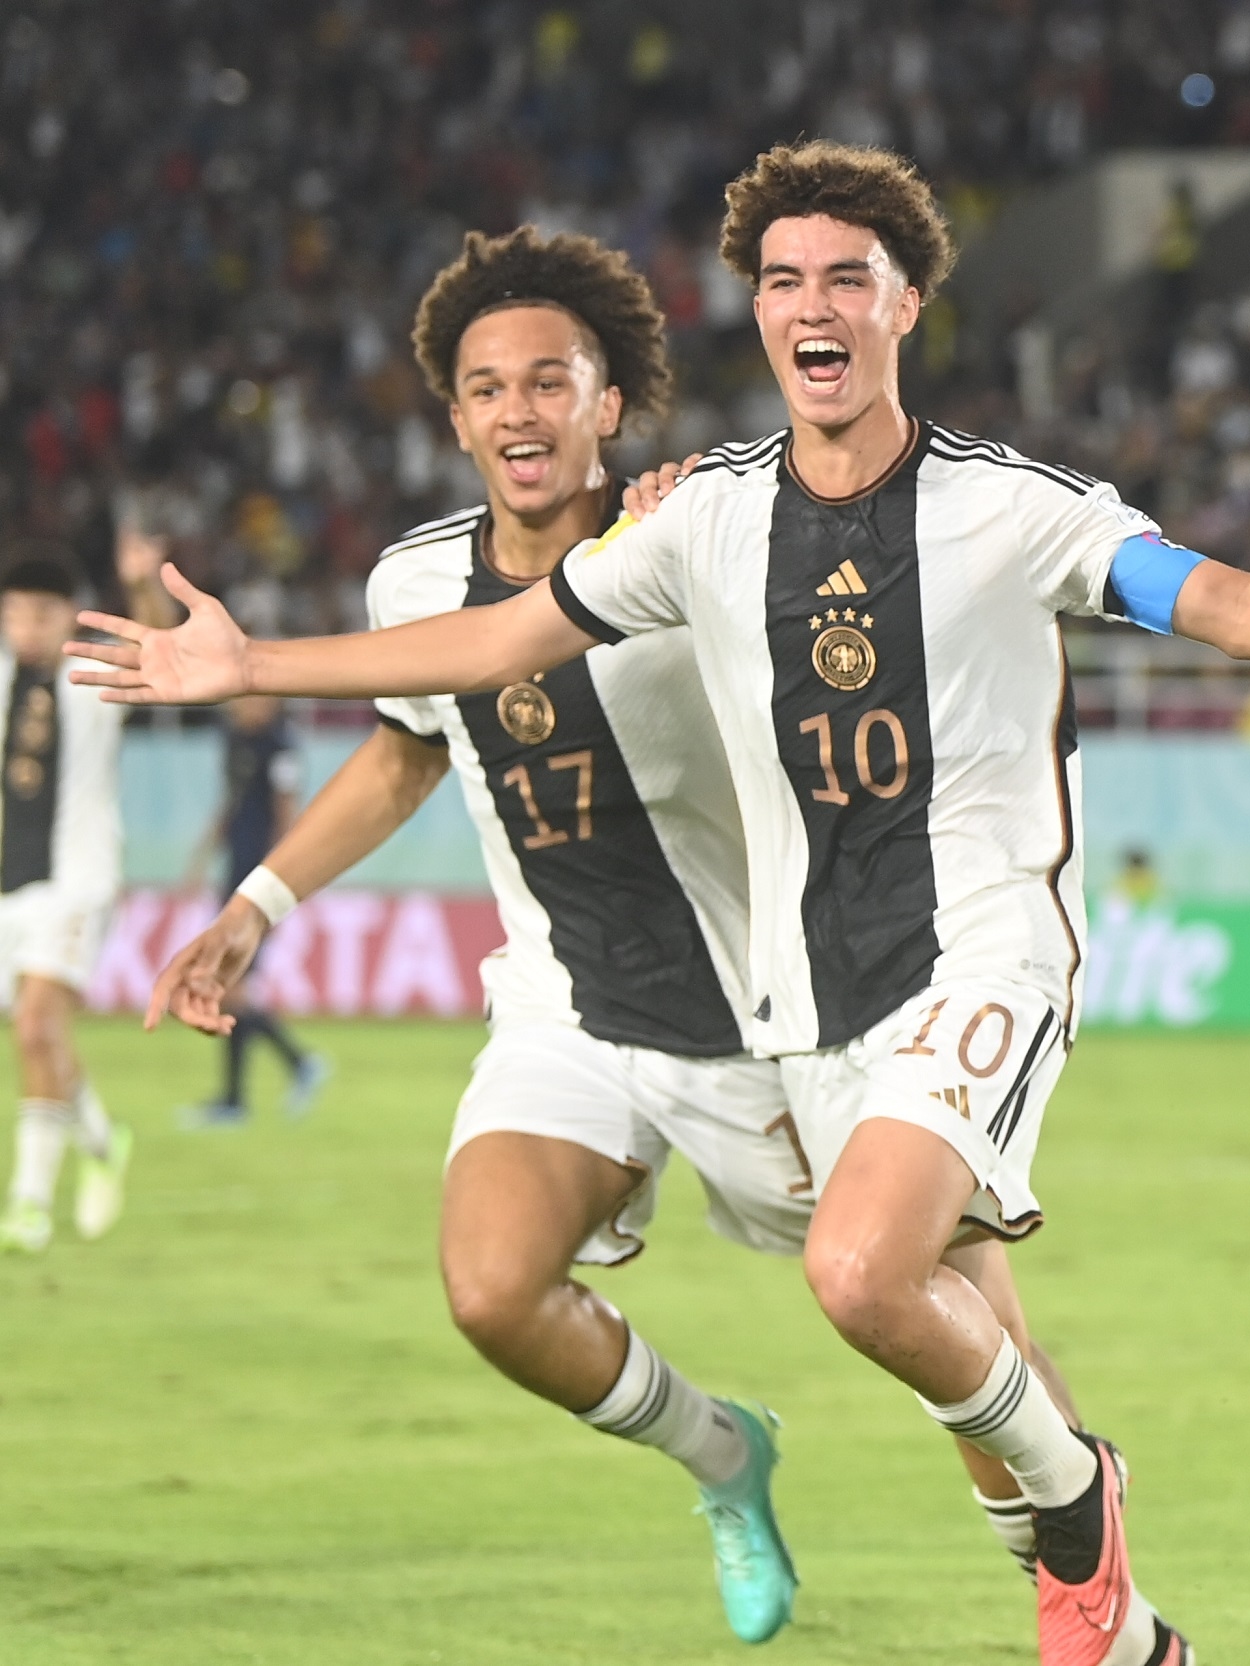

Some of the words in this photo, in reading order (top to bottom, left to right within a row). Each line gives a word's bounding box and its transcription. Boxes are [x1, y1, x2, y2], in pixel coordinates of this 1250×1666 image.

[503, 749, 594, 851] 17
[798, 708, 909, 806] 10
[893, 997, 1015, 1079] 10
